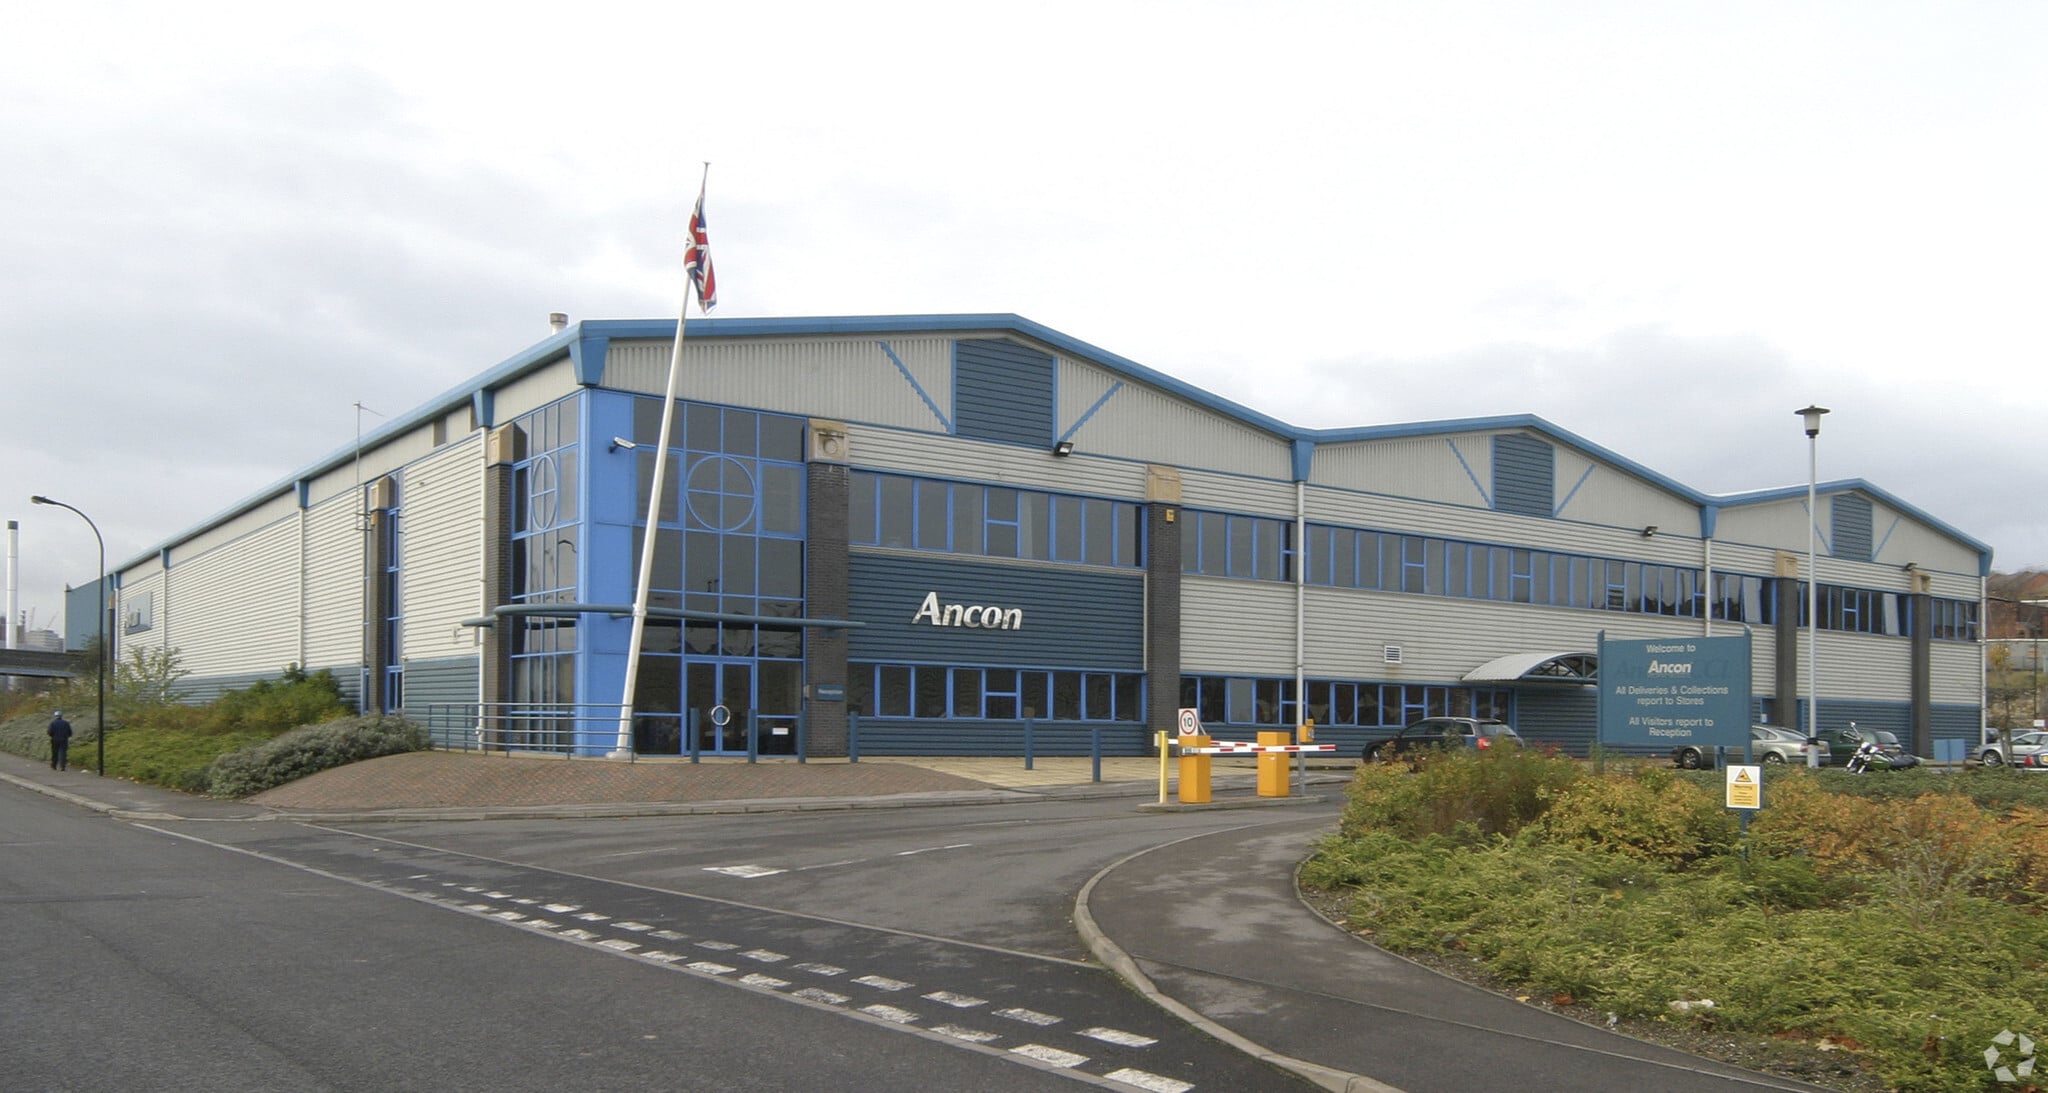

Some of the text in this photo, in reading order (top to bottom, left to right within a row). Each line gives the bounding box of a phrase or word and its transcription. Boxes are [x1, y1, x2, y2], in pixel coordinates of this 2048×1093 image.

[911, 591, 1023, 630] Ancon
[1646, 644, 1696, 653] Welcome to
[1648, 660, 1692, 674] Ancon
[1615, 685, 1729, 695] All Deliveries & Collections
[1637, 696, 1704, 706] report to Stores
[1183, 717, 1193, 727] 10
[1629, 717, 1714, 728] All Visitors report to
[1649, 727, 1692, 738] Reception
